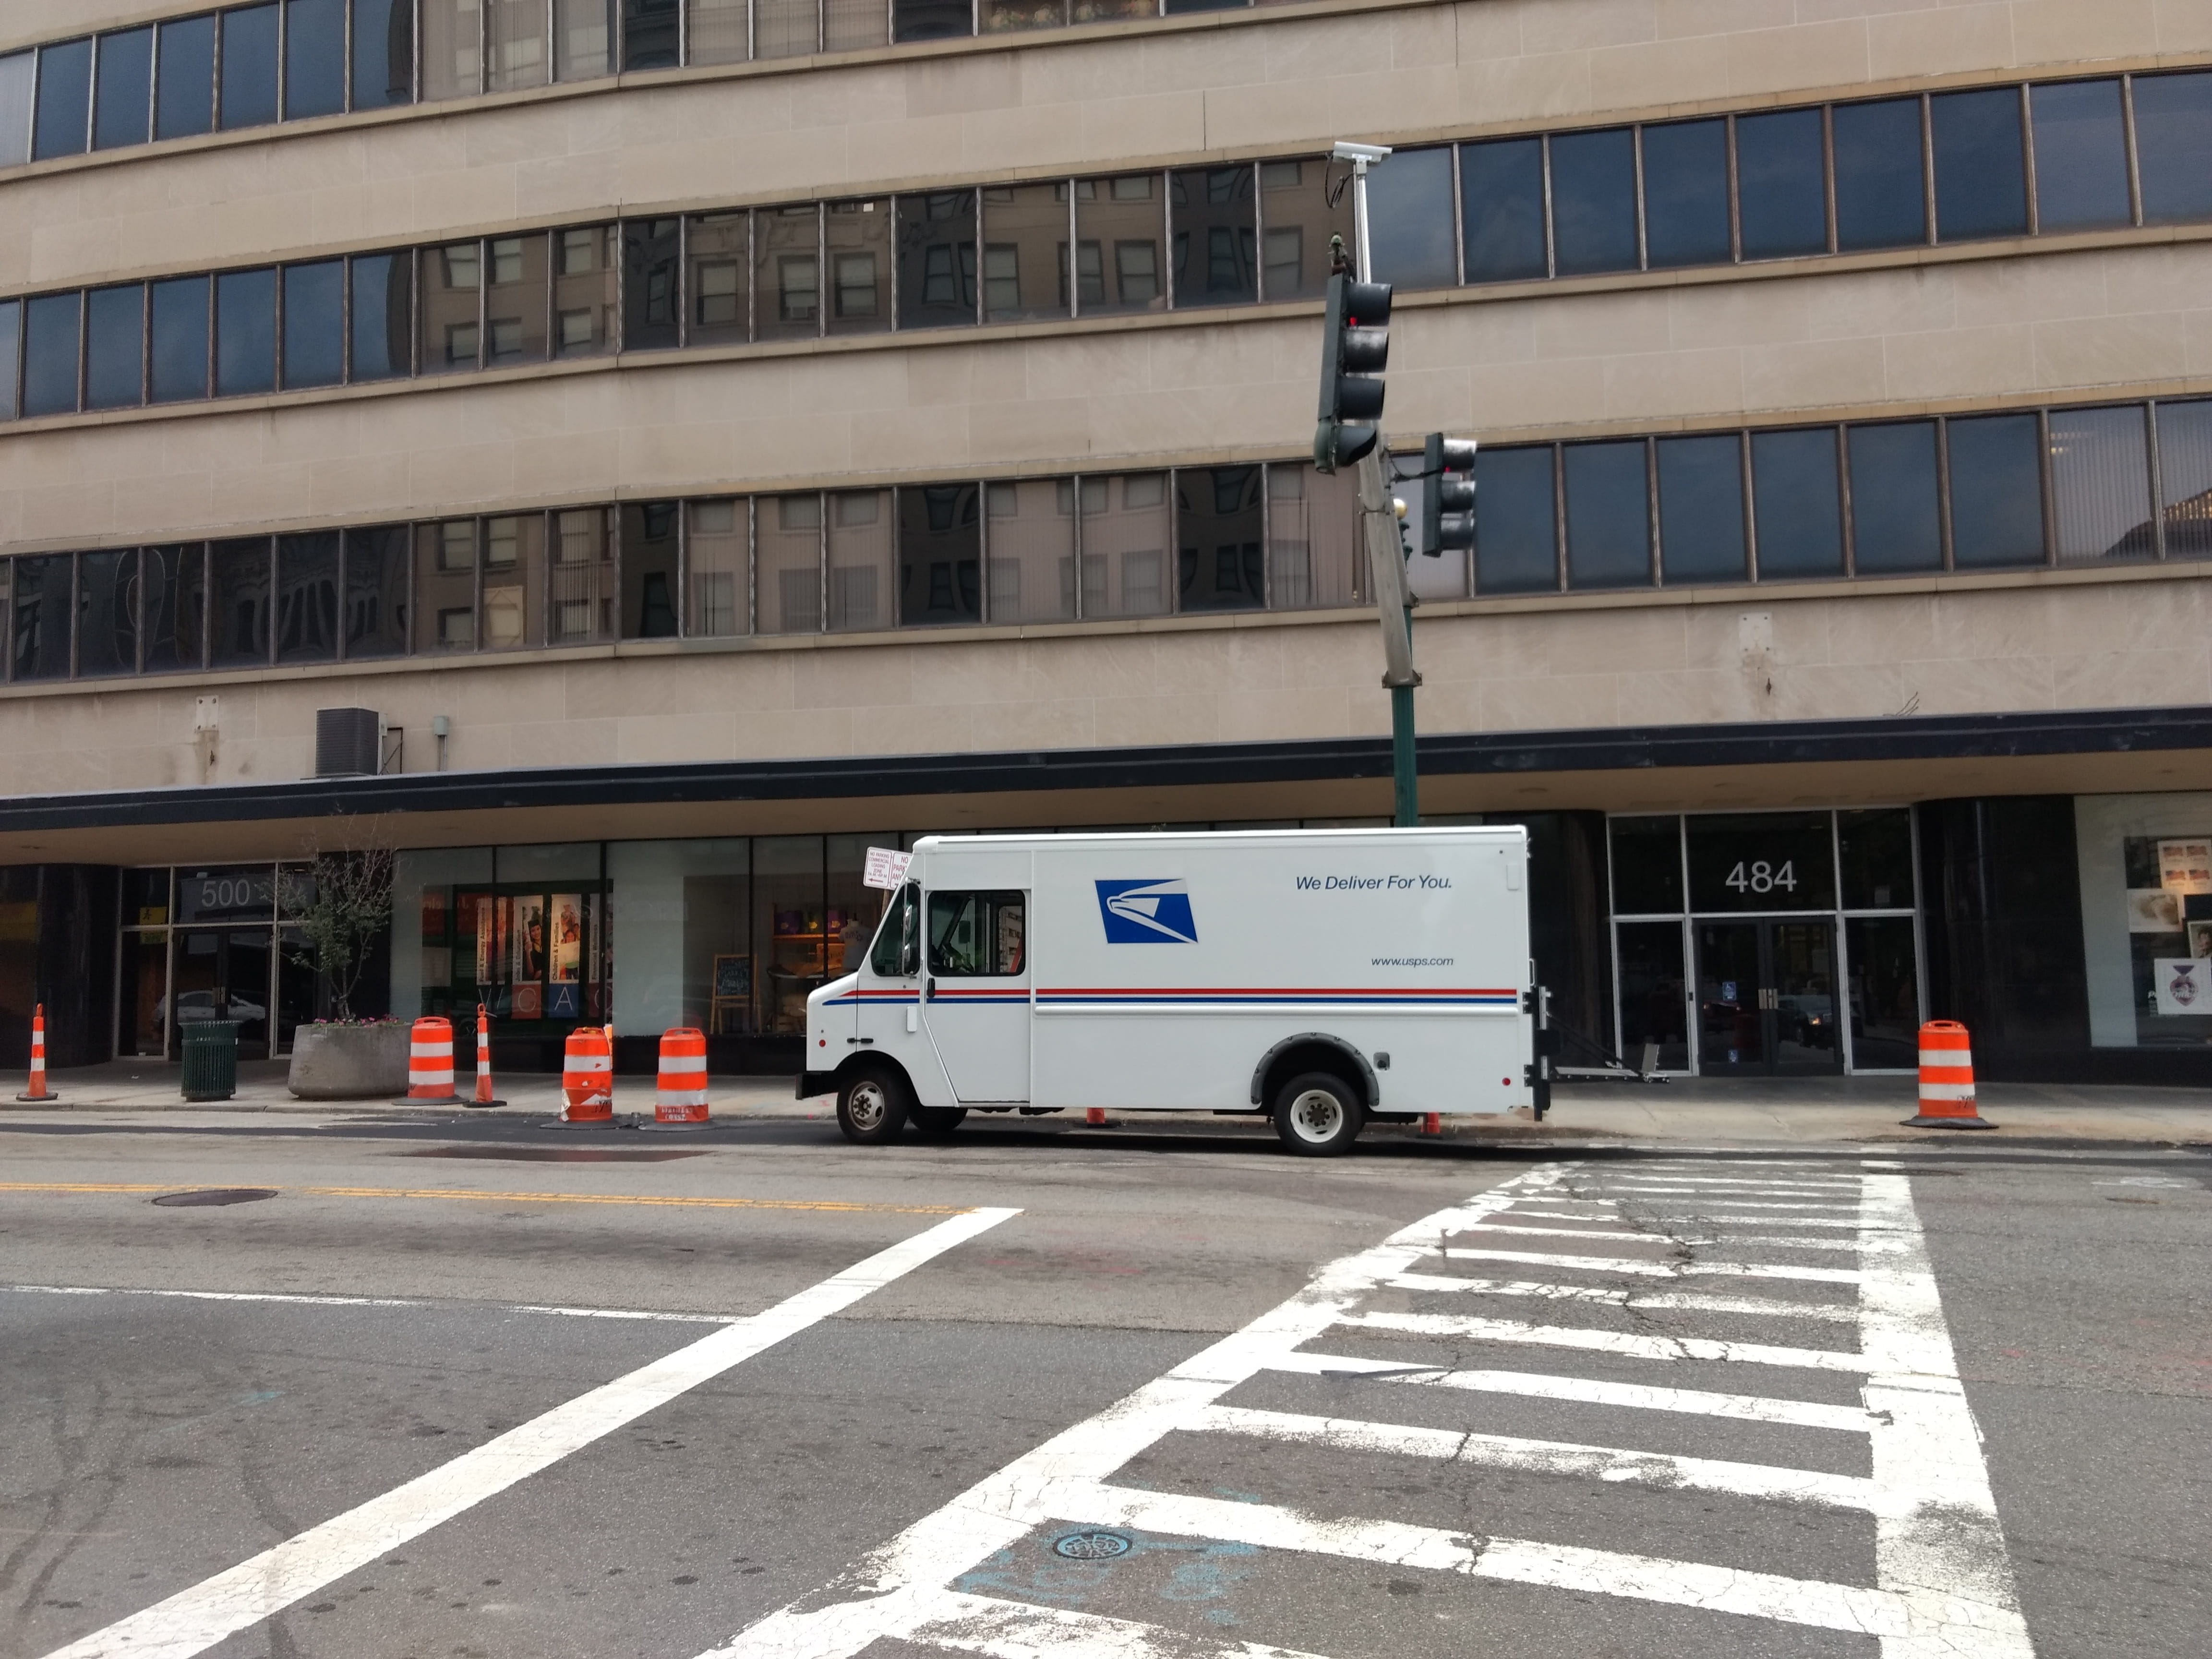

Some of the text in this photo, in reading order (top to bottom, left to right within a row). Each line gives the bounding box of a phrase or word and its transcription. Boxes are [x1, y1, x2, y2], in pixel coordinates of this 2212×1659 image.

[1296, 875, 1452, 890] We Deliver For You.
[1725, 860, 1797, 893] 484
[202, 879, 250, 907] 500
[1371, 958, 1454, 968] www.usps.com
[554, 986, 573, 1010] A
